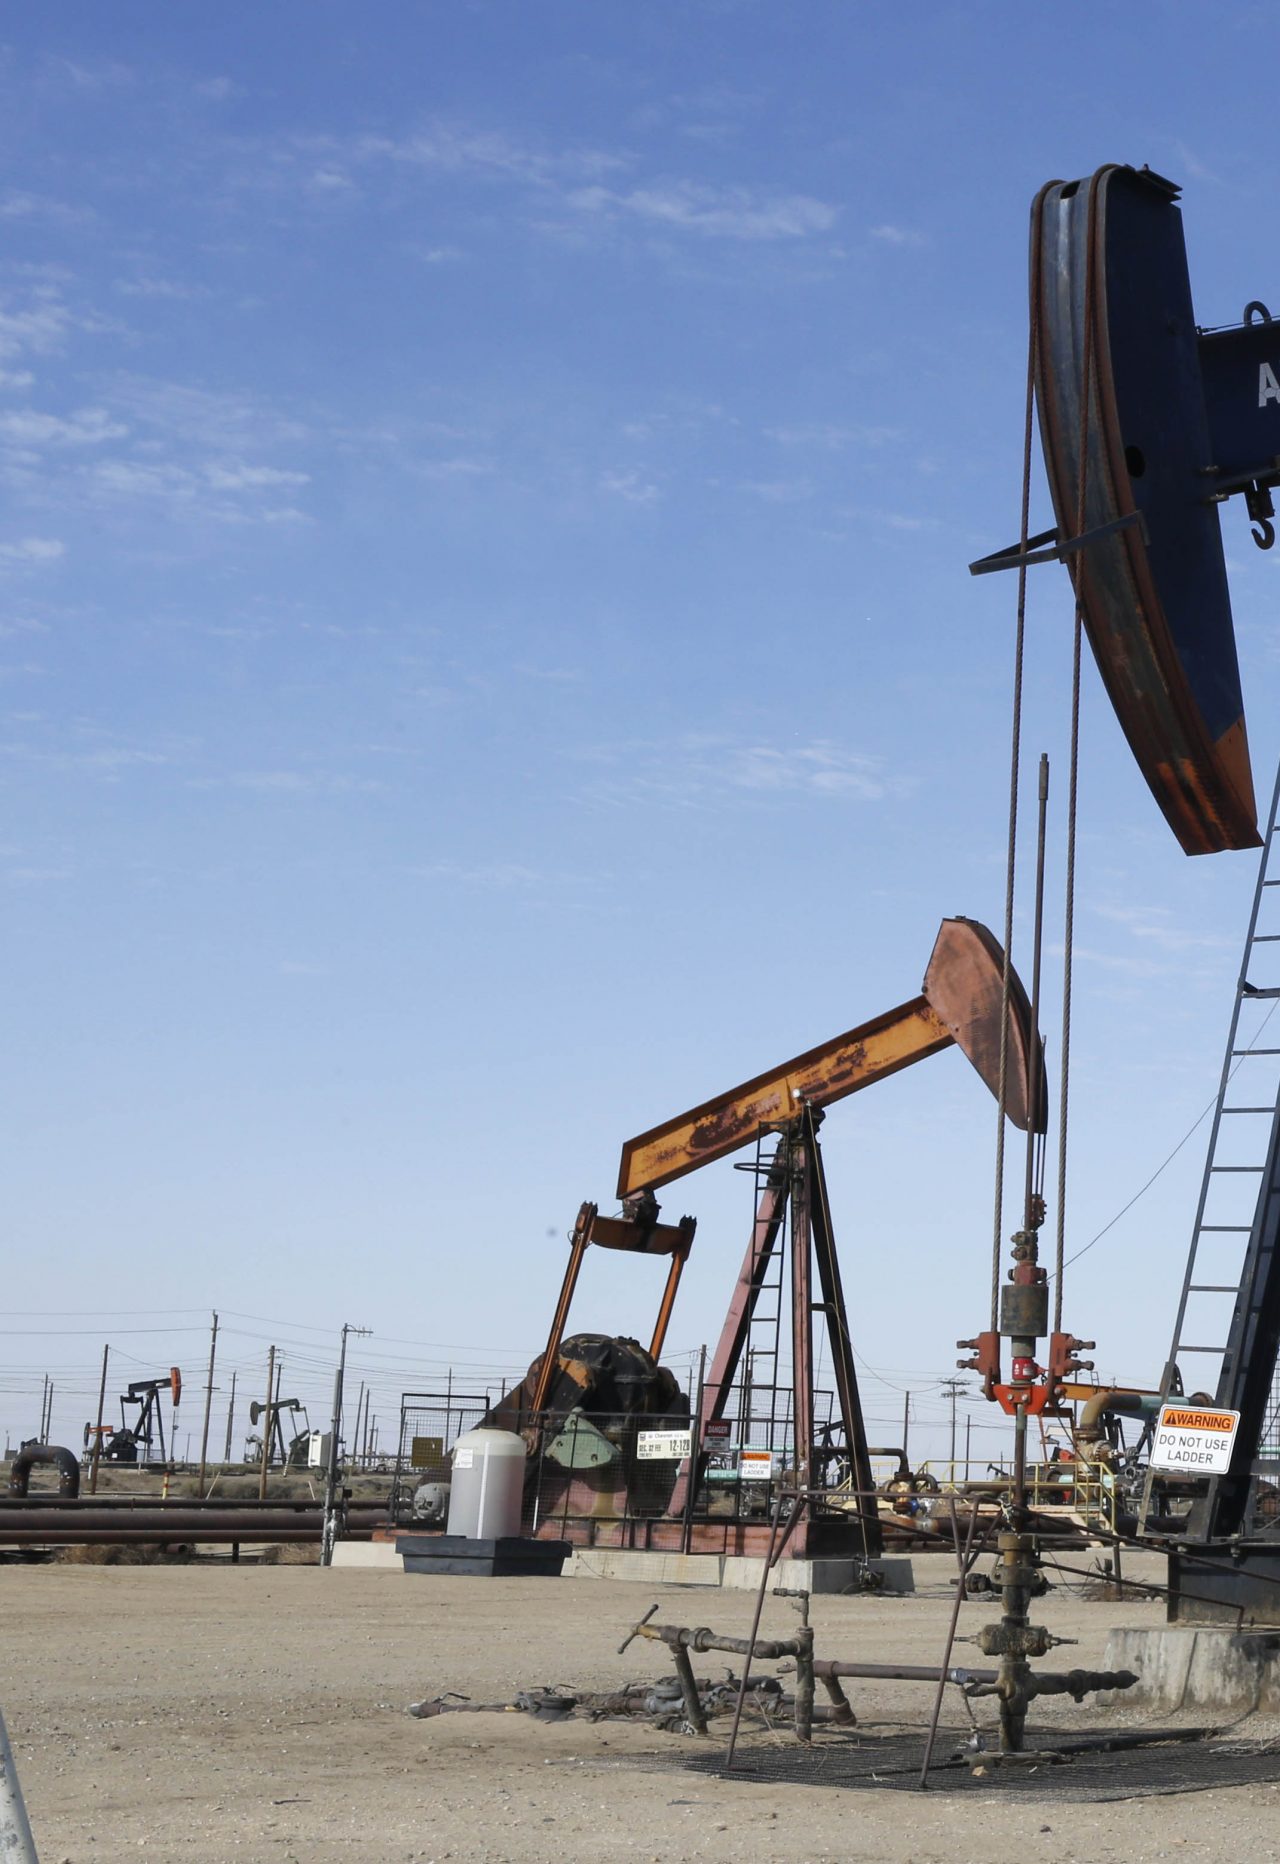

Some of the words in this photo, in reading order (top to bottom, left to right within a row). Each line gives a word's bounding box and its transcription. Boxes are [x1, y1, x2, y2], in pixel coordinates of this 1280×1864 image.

[1177, 1413, 1231, 1429] WARNING
[707, 1425, 728, 1434] DANGER
[1159, 1434, 1176, 1446] DO
[1178, 1436, 1203, 1448] NOT
[1205, 1438, 1229, 1451] USE
[1167, 1450, 1214, 1464] LADDER
